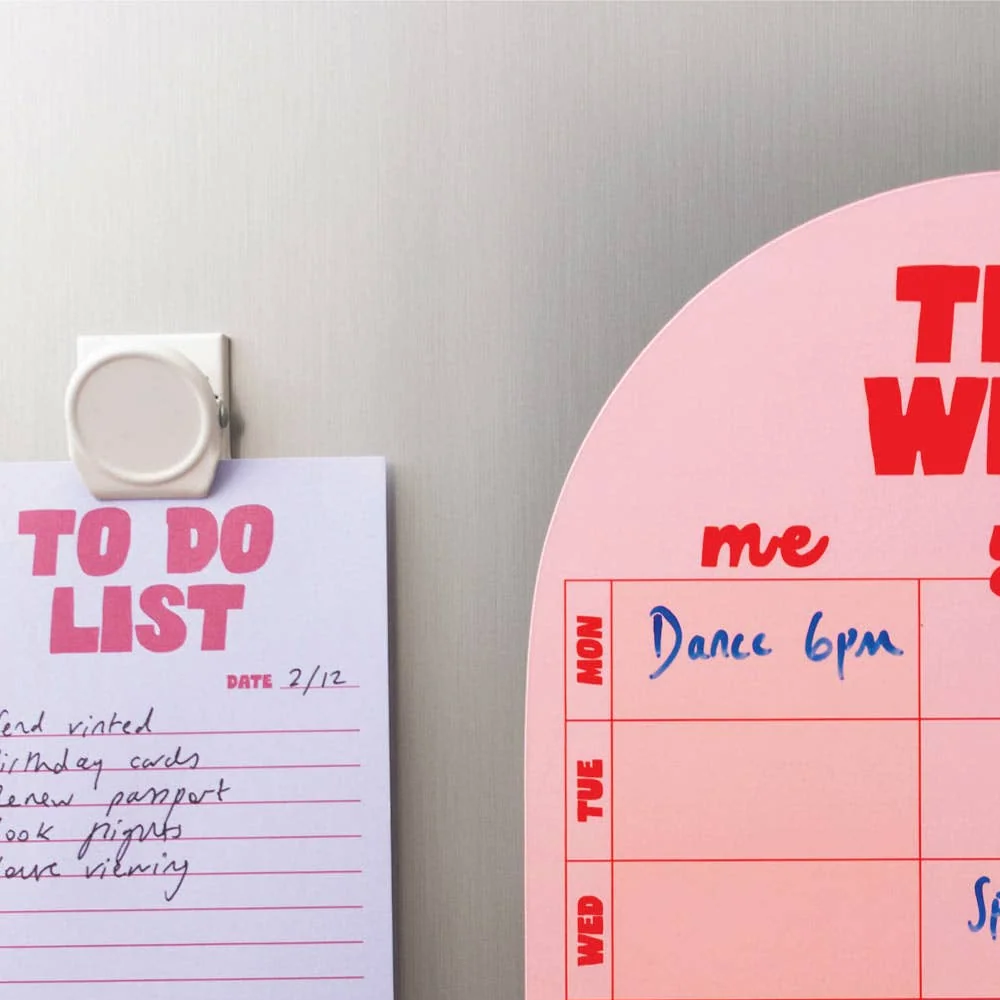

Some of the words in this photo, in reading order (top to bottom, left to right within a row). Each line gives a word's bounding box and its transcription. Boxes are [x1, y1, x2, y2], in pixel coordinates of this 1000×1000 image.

[17, 506, 132, 577] TO
[166, 503, 275, 575] DO
[700, 522, 830, 569] me
[49, 583, 246, 655] LIST
[649, 605, 773, 680] Dance
[804, 610, 905, 681] 6pm
[576, 615, 604, 686] MON
[226, 673, 273, 690] DATE
[288, 664, 347, 696] 2/12
[69, 706, 155, 738] vinted
[0, 748, 104, 790] irthday
[130, 746, 200, 770] cards
[576, 758, 604, 823] TUE
[0, 784, 74, 808] enew
[105, 777, 231, 830] passport
[0, 816, 54, 842] ook
[576, 895, 604, 967] WED
